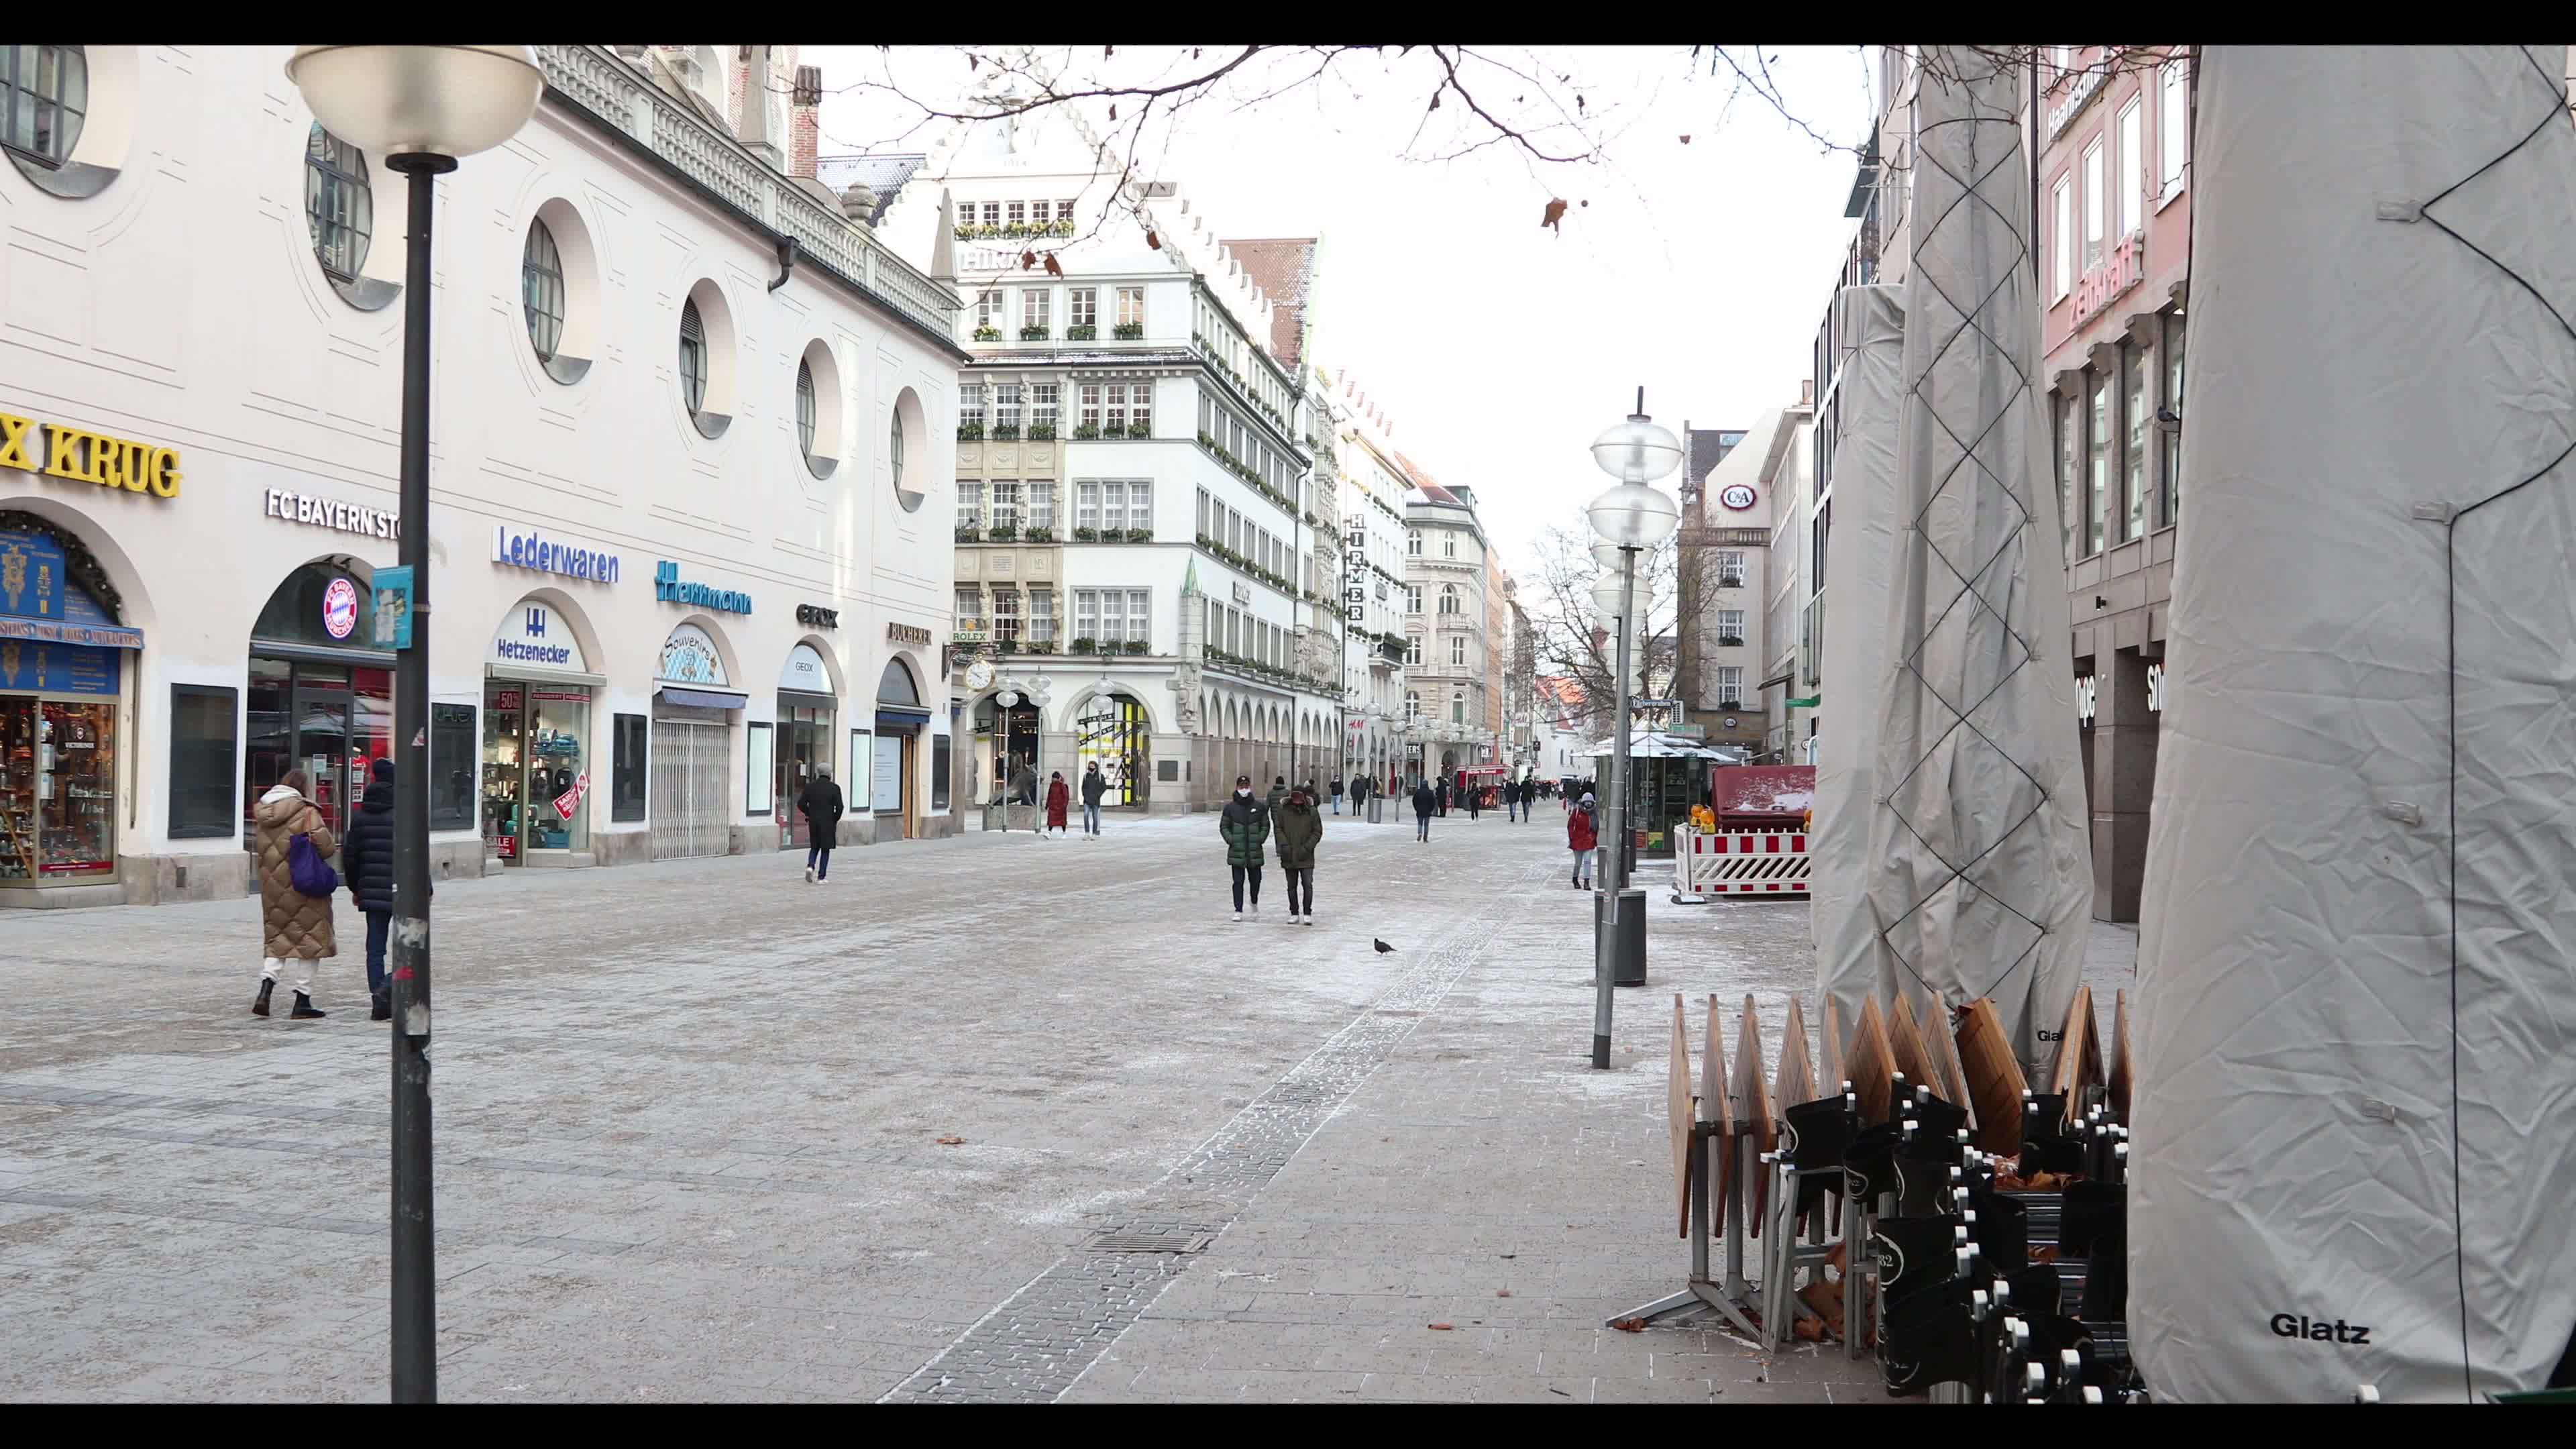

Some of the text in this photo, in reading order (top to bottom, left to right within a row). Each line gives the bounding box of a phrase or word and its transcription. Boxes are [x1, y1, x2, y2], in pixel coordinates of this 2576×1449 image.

[40, 423, 184, 498] KRUG
[1727, 491, 1750, 503] C&A
[266, 488, 400, 540] FC BAYERN ST
[499, 525, 619, 584] Lederwaren
[1348, 514, 1364, 621] HIRMER
[654, 559, 752, 615] Herrmann
[796, 604, 839, 629] GEOX
[889, 622, 932, 645] BUCHERER
[953, 633, 987, 641] ROLEX
[497, 638, 570, 664] Hetzenecker
[665, 635, 710, 661] Souvenirs
[795, 661, 814, 672] GEOX
[2270, 1313, 2371, 1344] Glatz
